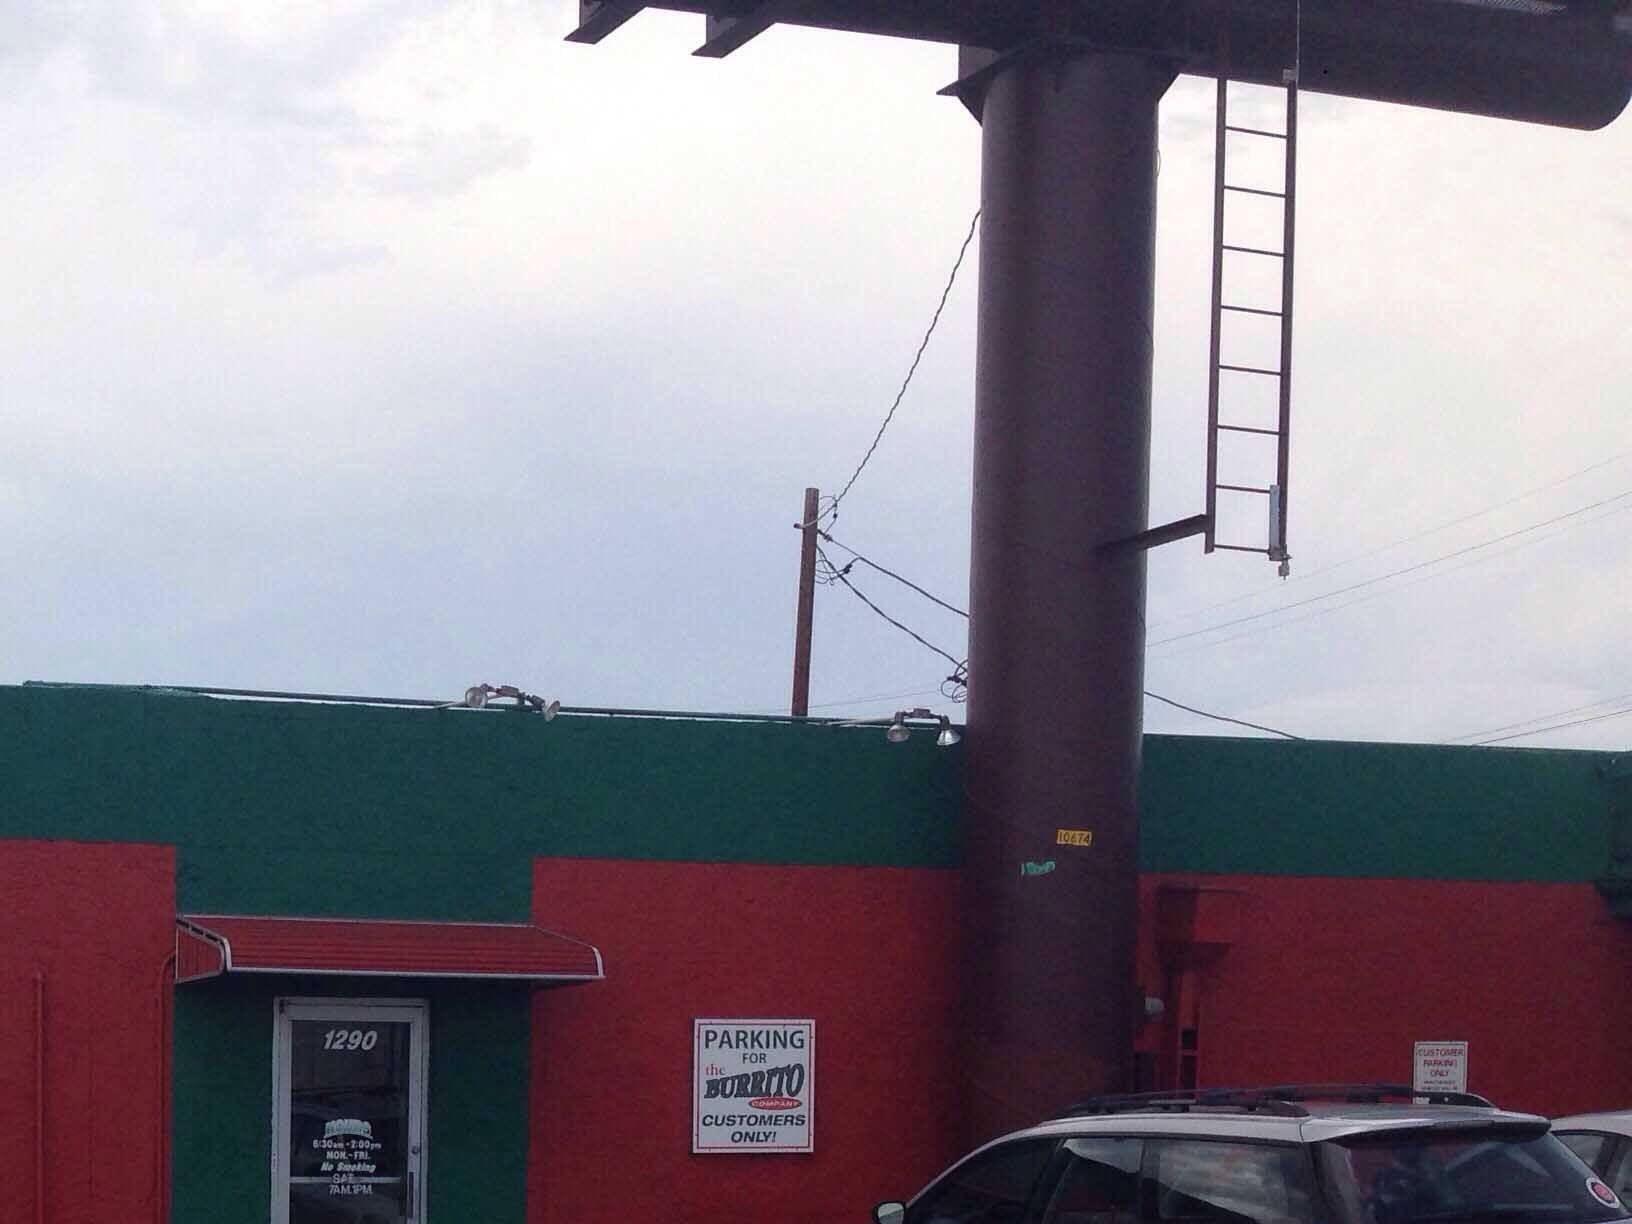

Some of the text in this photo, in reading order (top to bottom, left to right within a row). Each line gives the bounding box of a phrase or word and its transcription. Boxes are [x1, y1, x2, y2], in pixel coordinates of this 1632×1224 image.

[323, 1029, 377, 1050] 1290
[704, 1030, 804, 1049] PARKING
[742, 1053, 767, 1064] FOR
[1417, 1048, 1464, 1056] CUSTOMER
[705, 1063, 726, 1076] the
[704, 1063, 805, 1098] BURRITO
[702, 1114, 806, 1127] CUSTOMERS
[730, 1131, 777, 1144] ONLY!
[336, 1162, 377, 1173] Smoking
